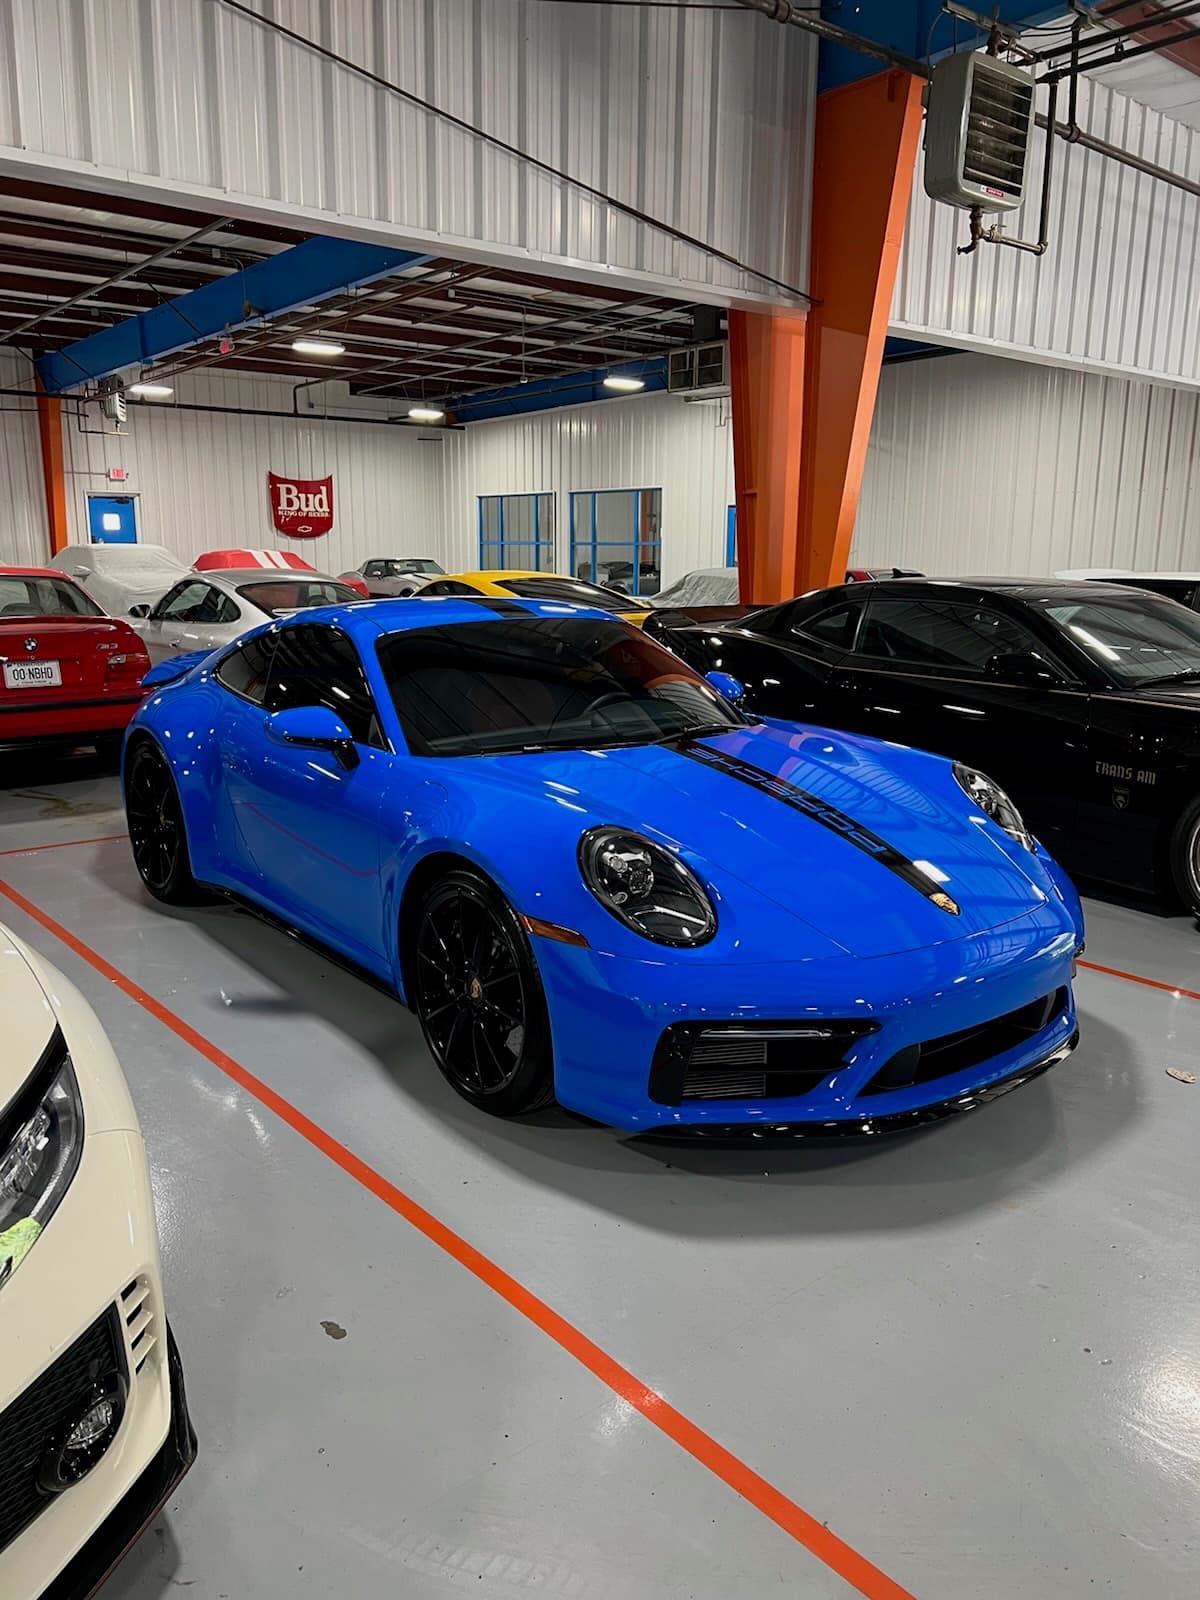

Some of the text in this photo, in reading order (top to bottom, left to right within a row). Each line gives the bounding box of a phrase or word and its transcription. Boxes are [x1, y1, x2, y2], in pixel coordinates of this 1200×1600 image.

[276, 483, 330, 512] Bud
[1095, 760, 1156, 785] TRANS AM
[687, 747, 888, 853] PORSCHE
